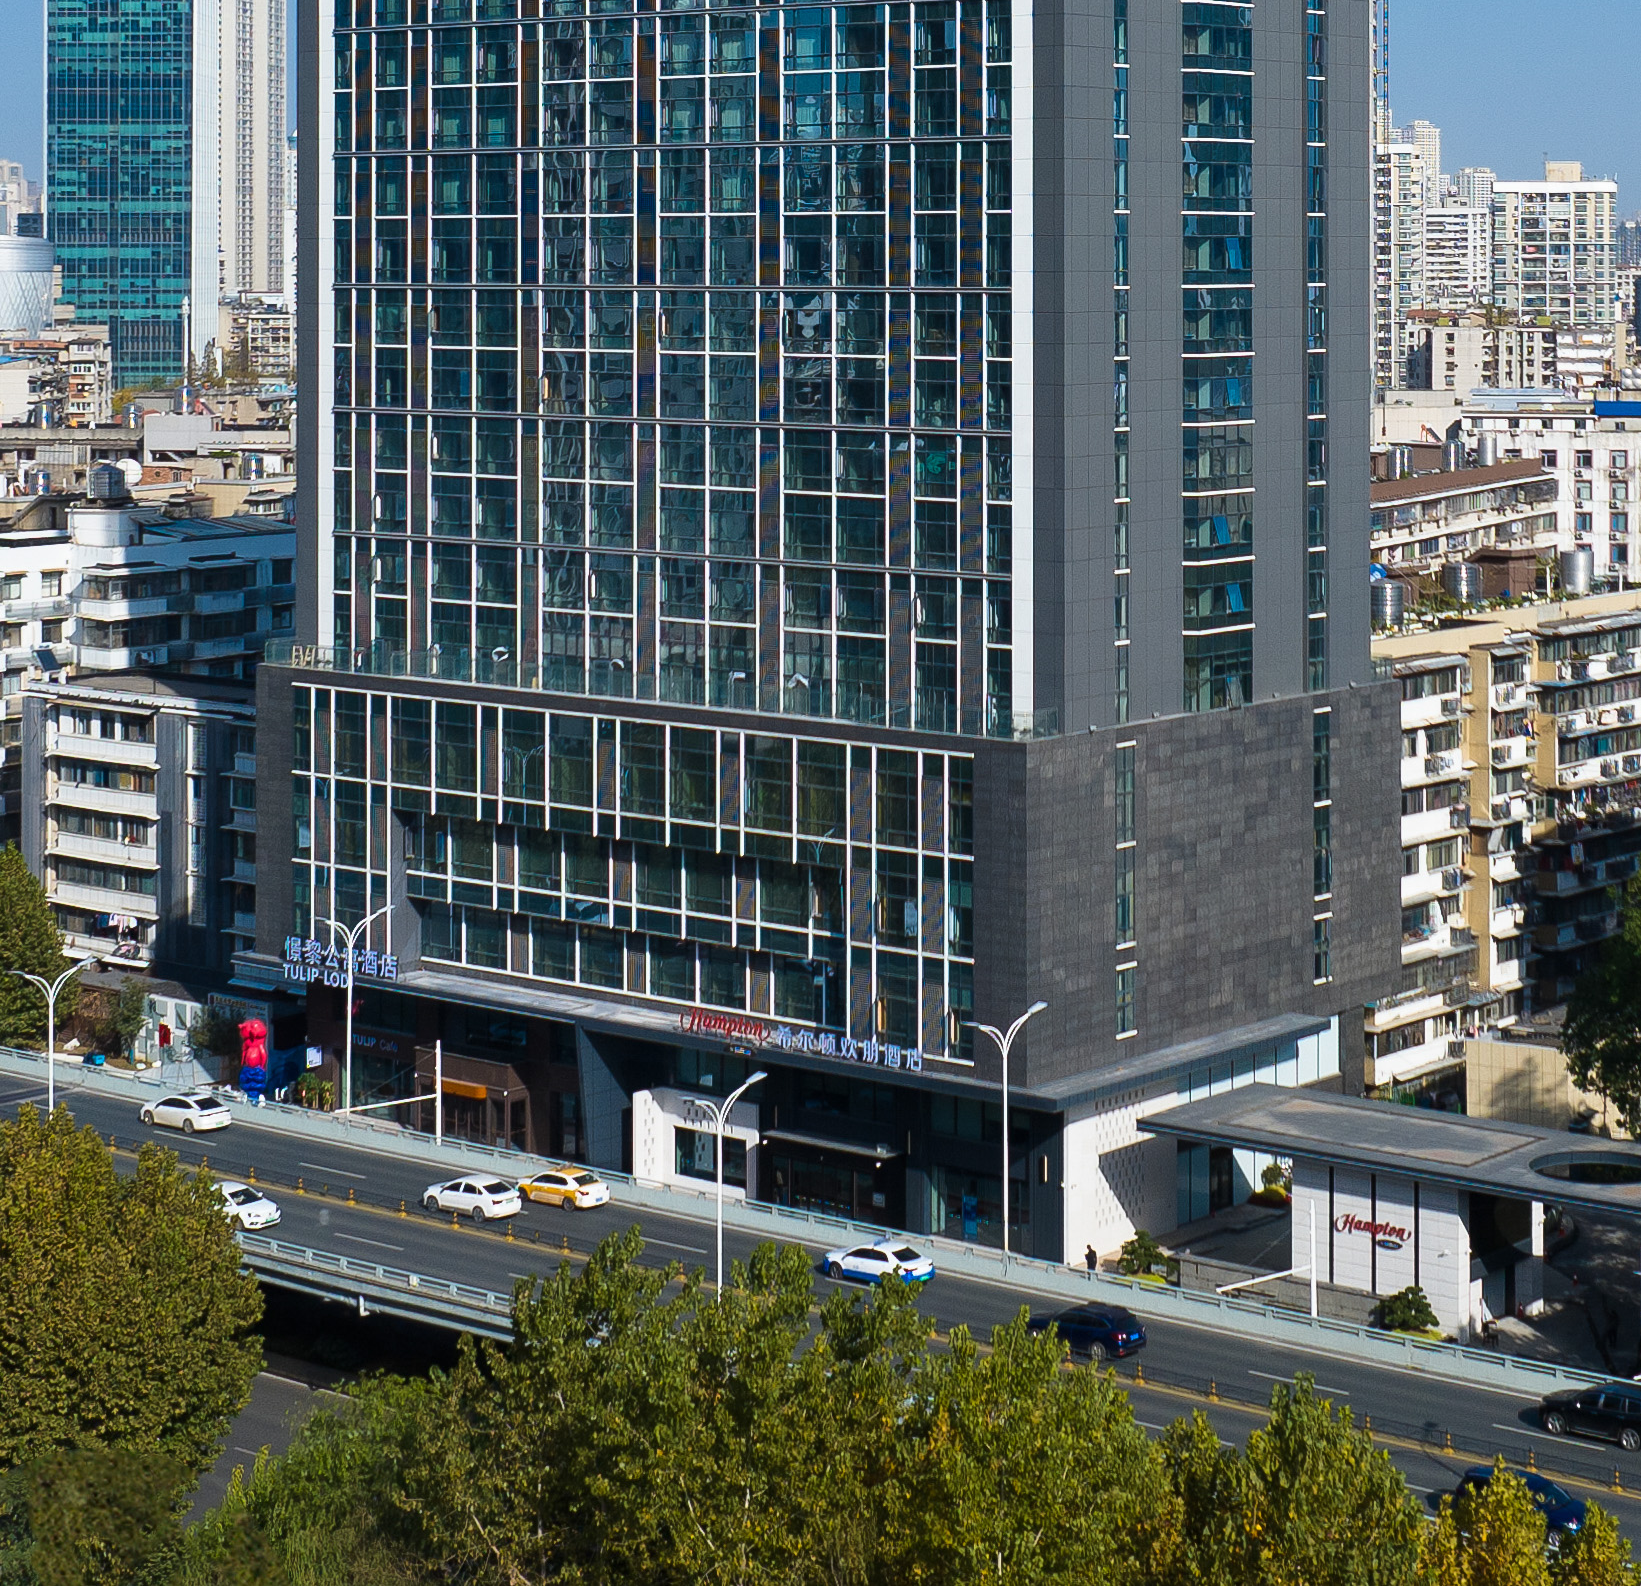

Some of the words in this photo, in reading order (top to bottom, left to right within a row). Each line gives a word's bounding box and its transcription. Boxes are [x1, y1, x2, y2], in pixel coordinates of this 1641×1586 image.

[283, 963, 320, 983] TULIP
[679, 1008, 772, 1042] Hampton
[777, 1024, 923, 1072] 希尔顿欢朋酒店
[1334, 1213, 1412, 1242] Hampton
